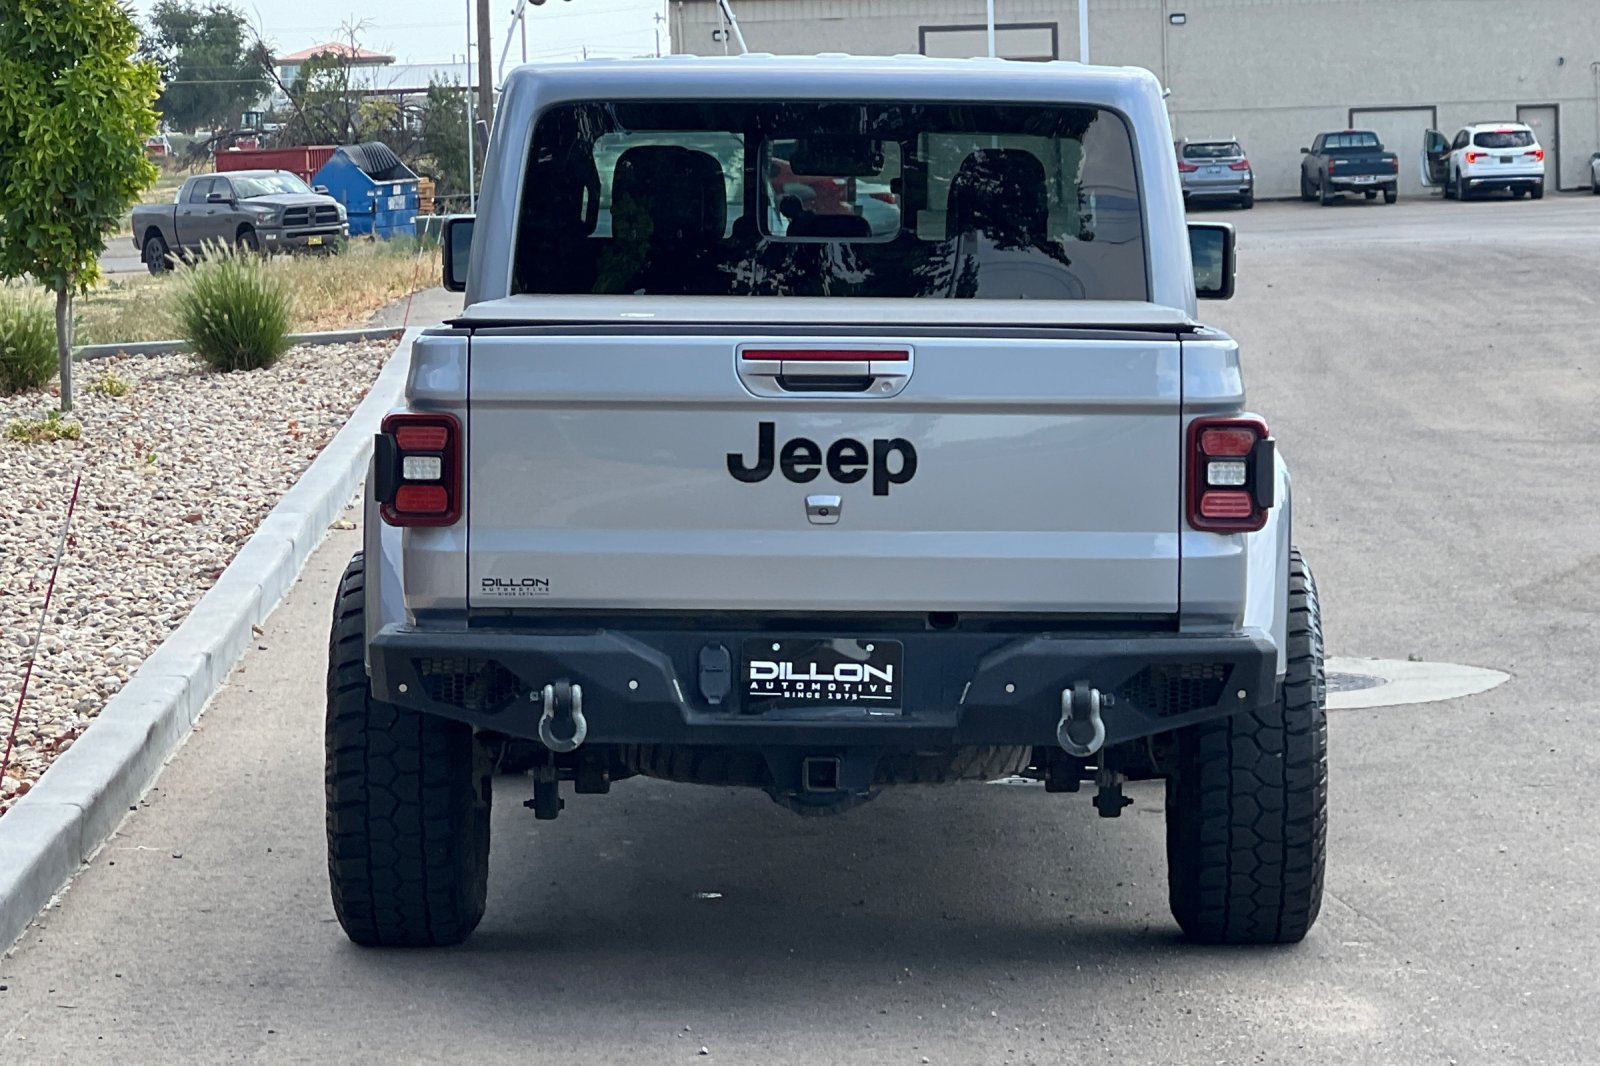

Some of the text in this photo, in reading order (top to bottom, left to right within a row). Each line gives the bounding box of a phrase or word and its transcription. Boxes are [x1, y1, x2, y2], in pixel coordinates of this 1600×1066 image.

[727, 422, 917, 495] Jeep
[482, 578, 549, 587] DILLON
[750, 661, 893, 683] DILLON
[750, 682, 892, 693] AUTOMOTIVE
